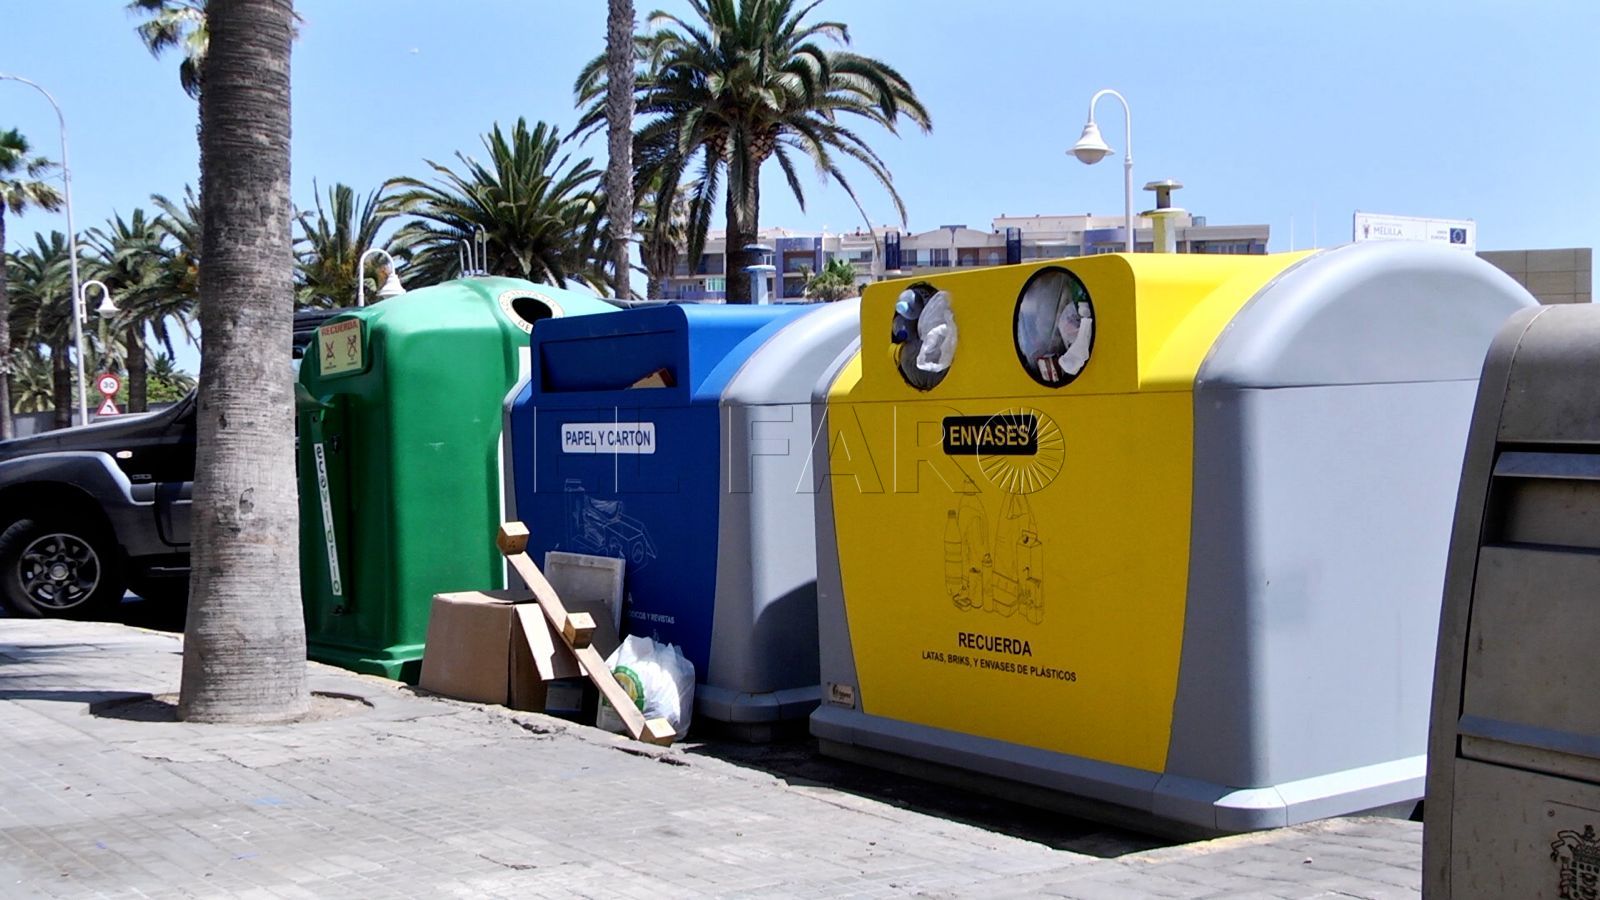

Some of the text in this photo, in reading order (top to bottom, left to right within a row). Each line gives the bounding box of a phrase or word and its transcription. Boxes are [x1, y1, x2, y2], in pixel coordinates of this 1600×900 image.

[103, 381, 115, 389] 30
[565, 431, 596, 446] PAPEL
[598, 431, 605, 446] Y
[949, 424, 1030, 446] ENVASES
[652, 613, 675, 624] REVISTAS
[958, 632, 1032, 656] RECUERDA
[922, 650, 947, 664] LATAS,
[947, 654, 973, 667] BRIKS,
[973, 657, 979, 667] Y
[980, 658, 1016, 673] ENVASES
[1017, 664, 1029, 675] DE
